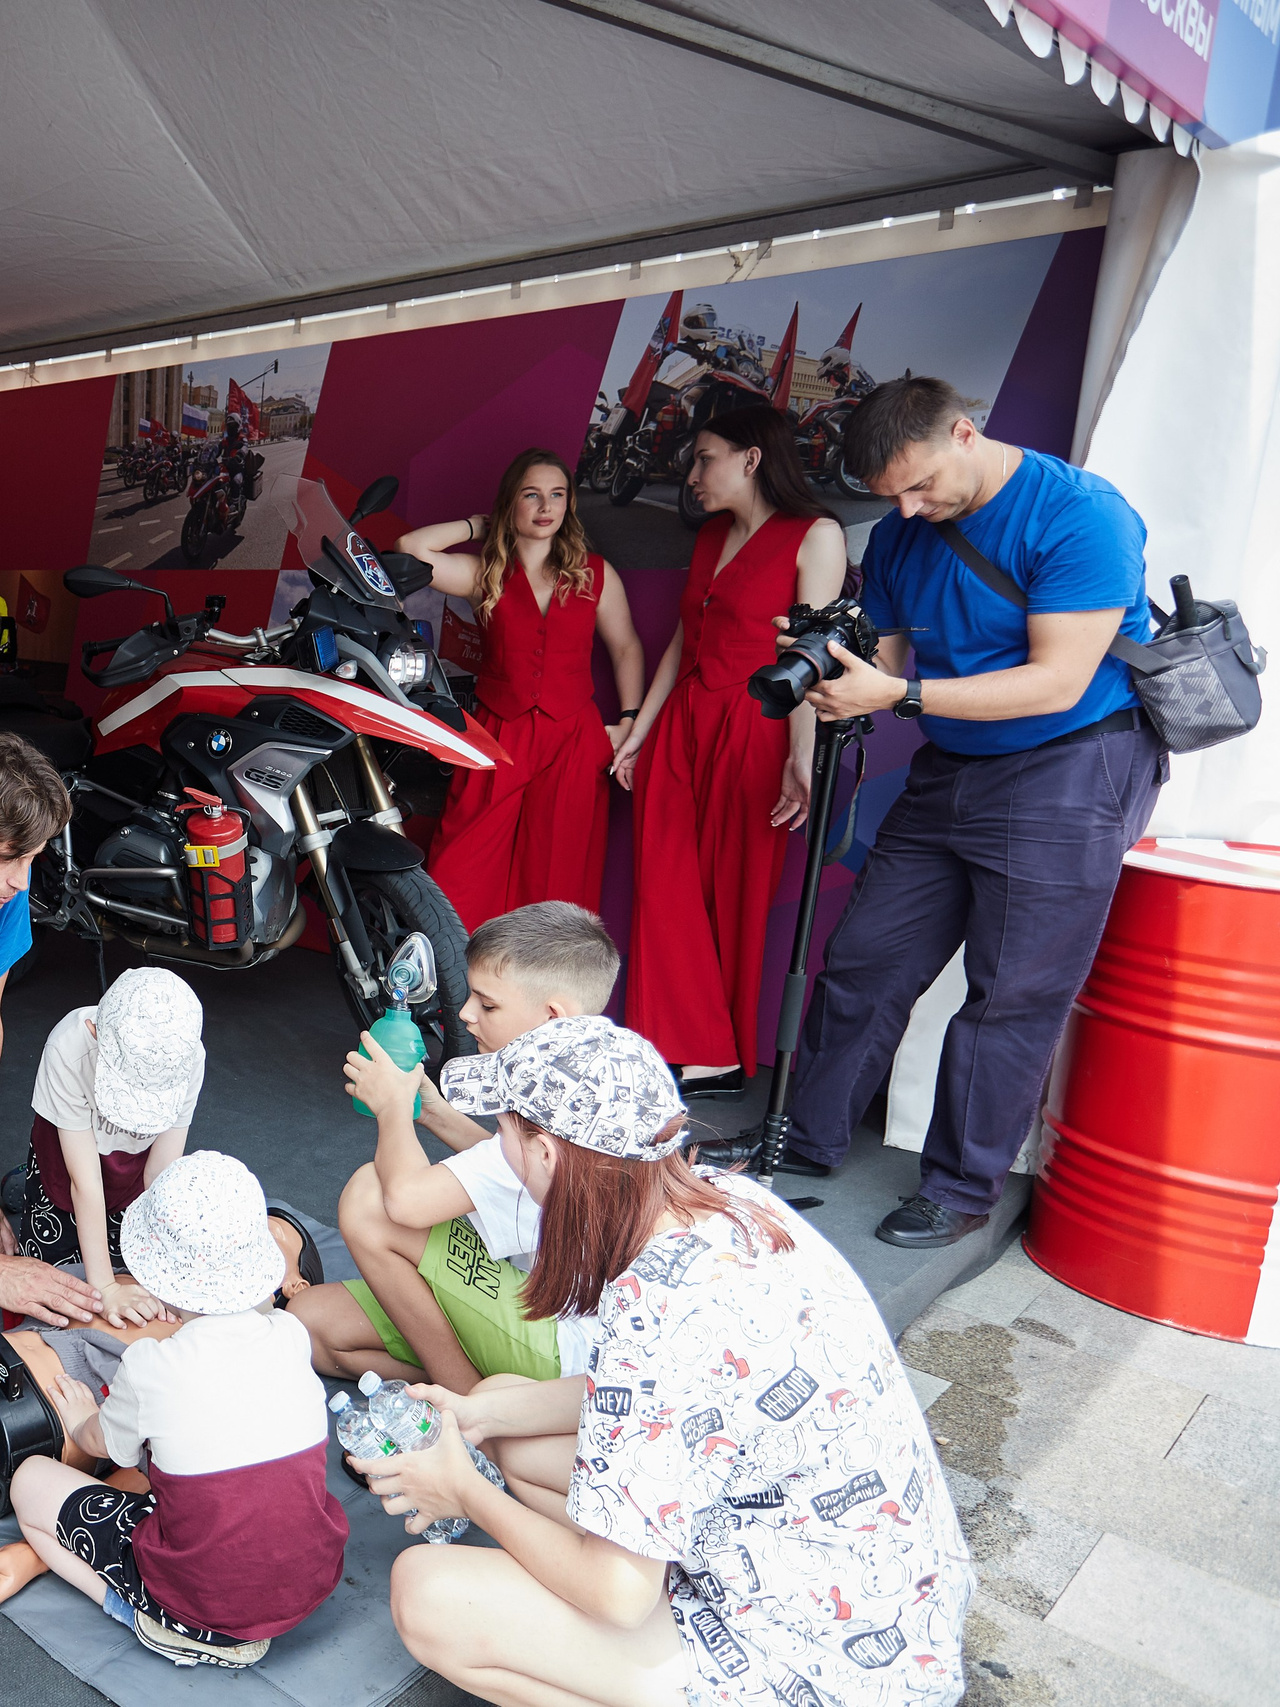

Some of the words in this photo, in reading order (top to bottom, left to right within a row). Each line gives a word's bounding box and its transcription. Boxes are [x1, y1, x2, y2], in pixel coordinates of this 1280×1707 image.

[243, 767, 289, 791] GS
[785, 1368, 815, 1398] UP!
[596, 1391, 628, 1415] HEY!
[852, 1472, 877, 1489] SEE
[820, 1501, 844, 1520] THAT
[845, 1485, 884, 1508] COMING.
